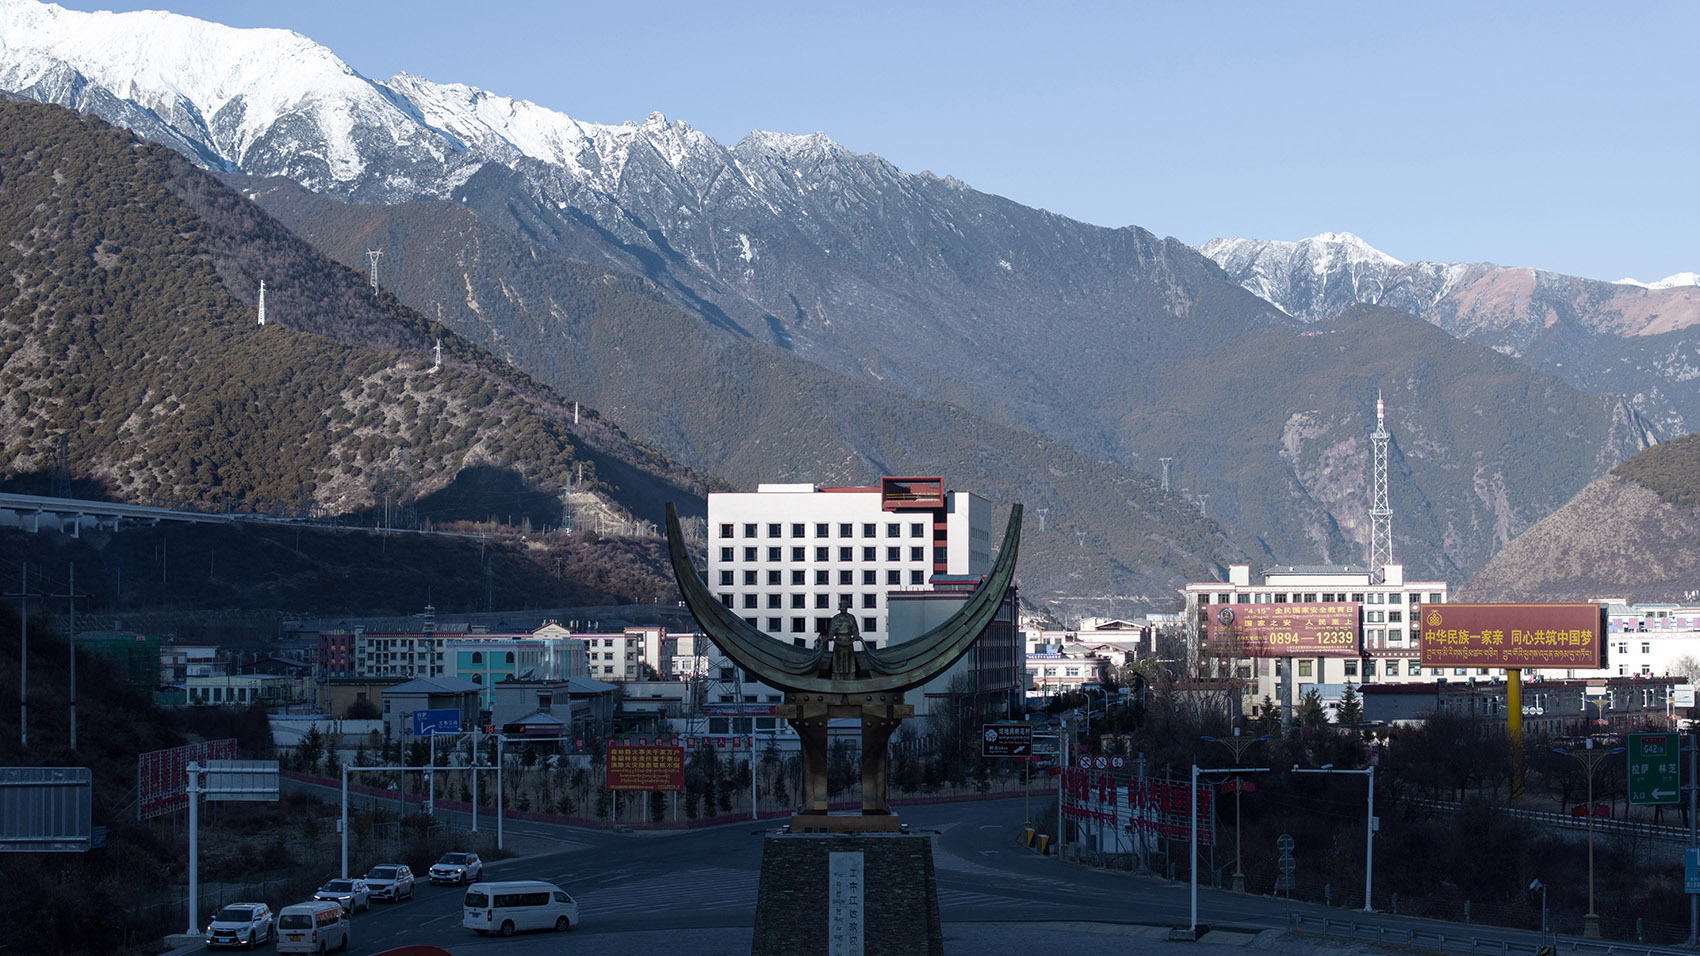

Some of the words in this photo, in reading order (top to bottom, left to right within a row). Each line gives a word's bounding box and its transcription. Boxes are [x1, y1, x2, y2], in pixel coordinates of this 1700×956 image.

[1275, 606, 1353, 614] 全民国家安全教育日
[1425, 629, 1504, 645] 中华民族一家亲
[1511, 629, 1593, 646] 同心共筑中国梦
[1631, 763, 1649, 775] 拉萨
[1658, 763, 1677, 774] 林芝
[1632, 791, 1646, 801] 入口
